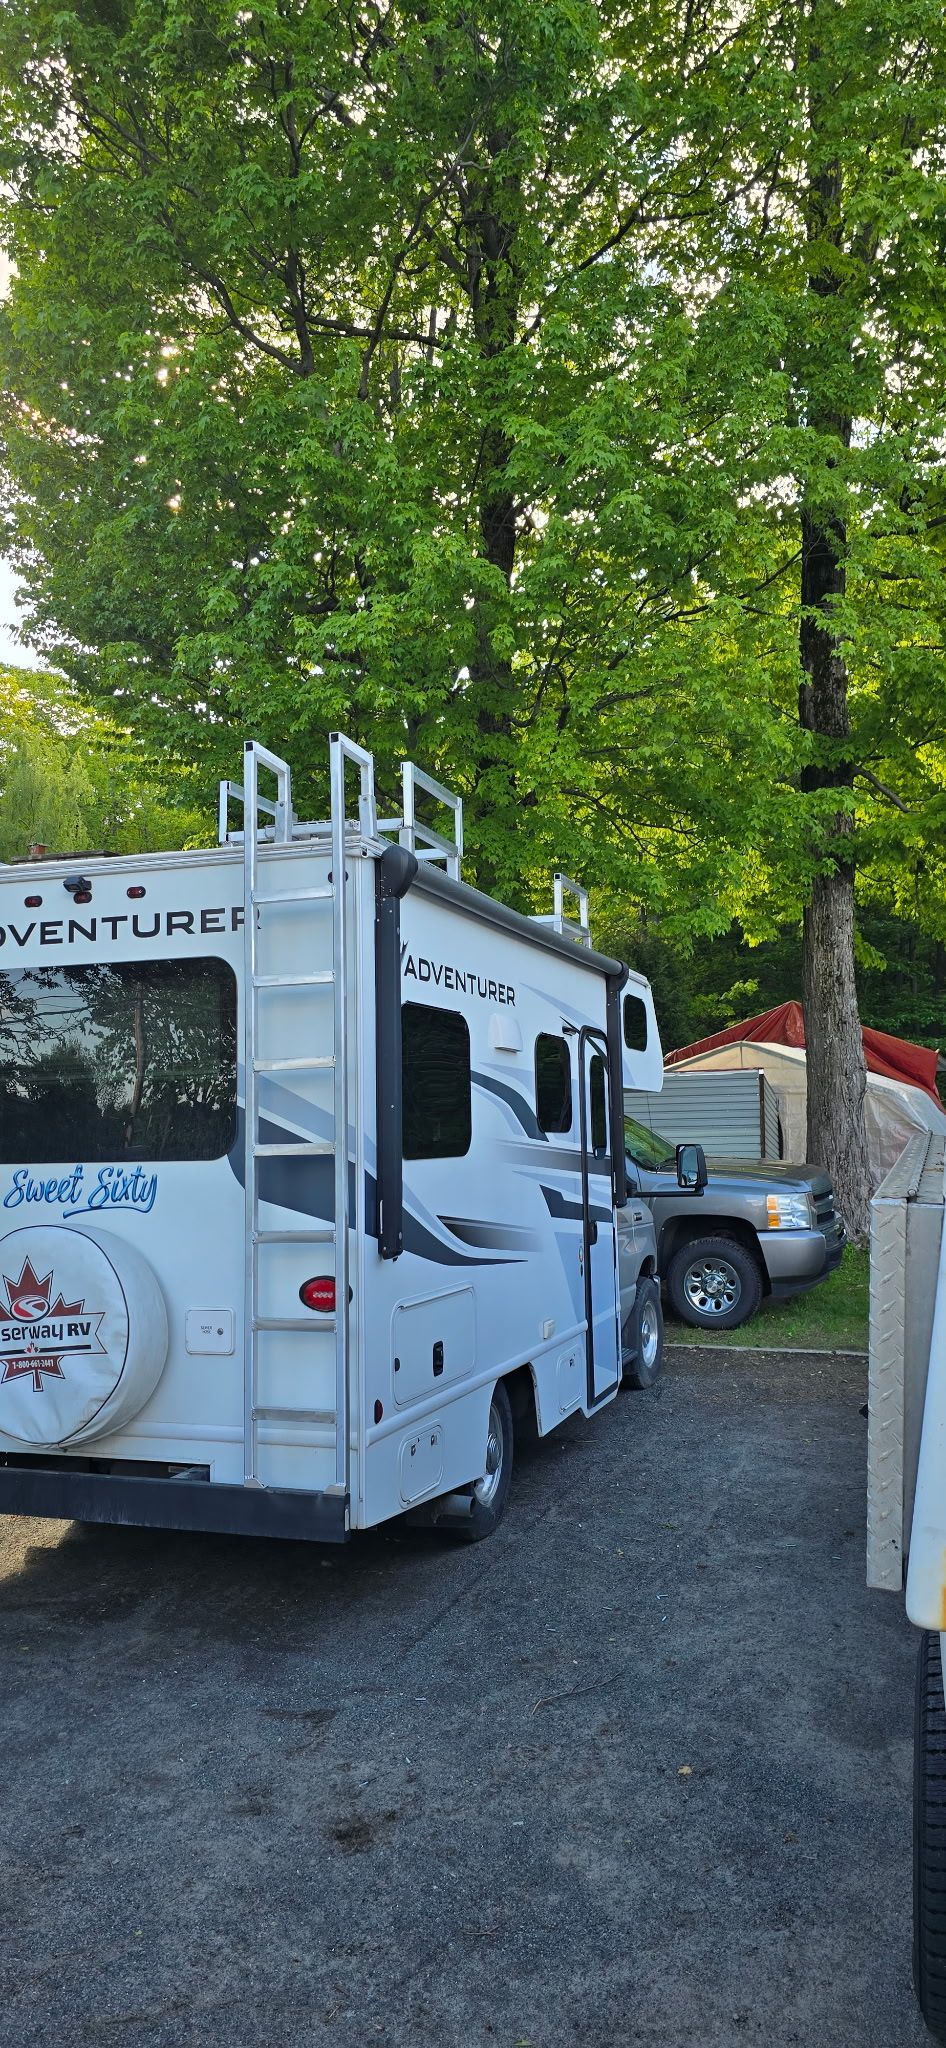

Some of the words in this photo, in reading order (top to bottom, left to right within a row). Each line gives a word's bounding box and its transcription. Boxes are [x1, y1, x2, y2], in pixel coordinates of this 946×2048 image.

[403, 954, 516, 1007] ADVENTURER
[3, 1164, 84, 1208] Sweet
[87, 1165, 158, 1215] Sixty
[67, 1321, 92, 1337] RV
